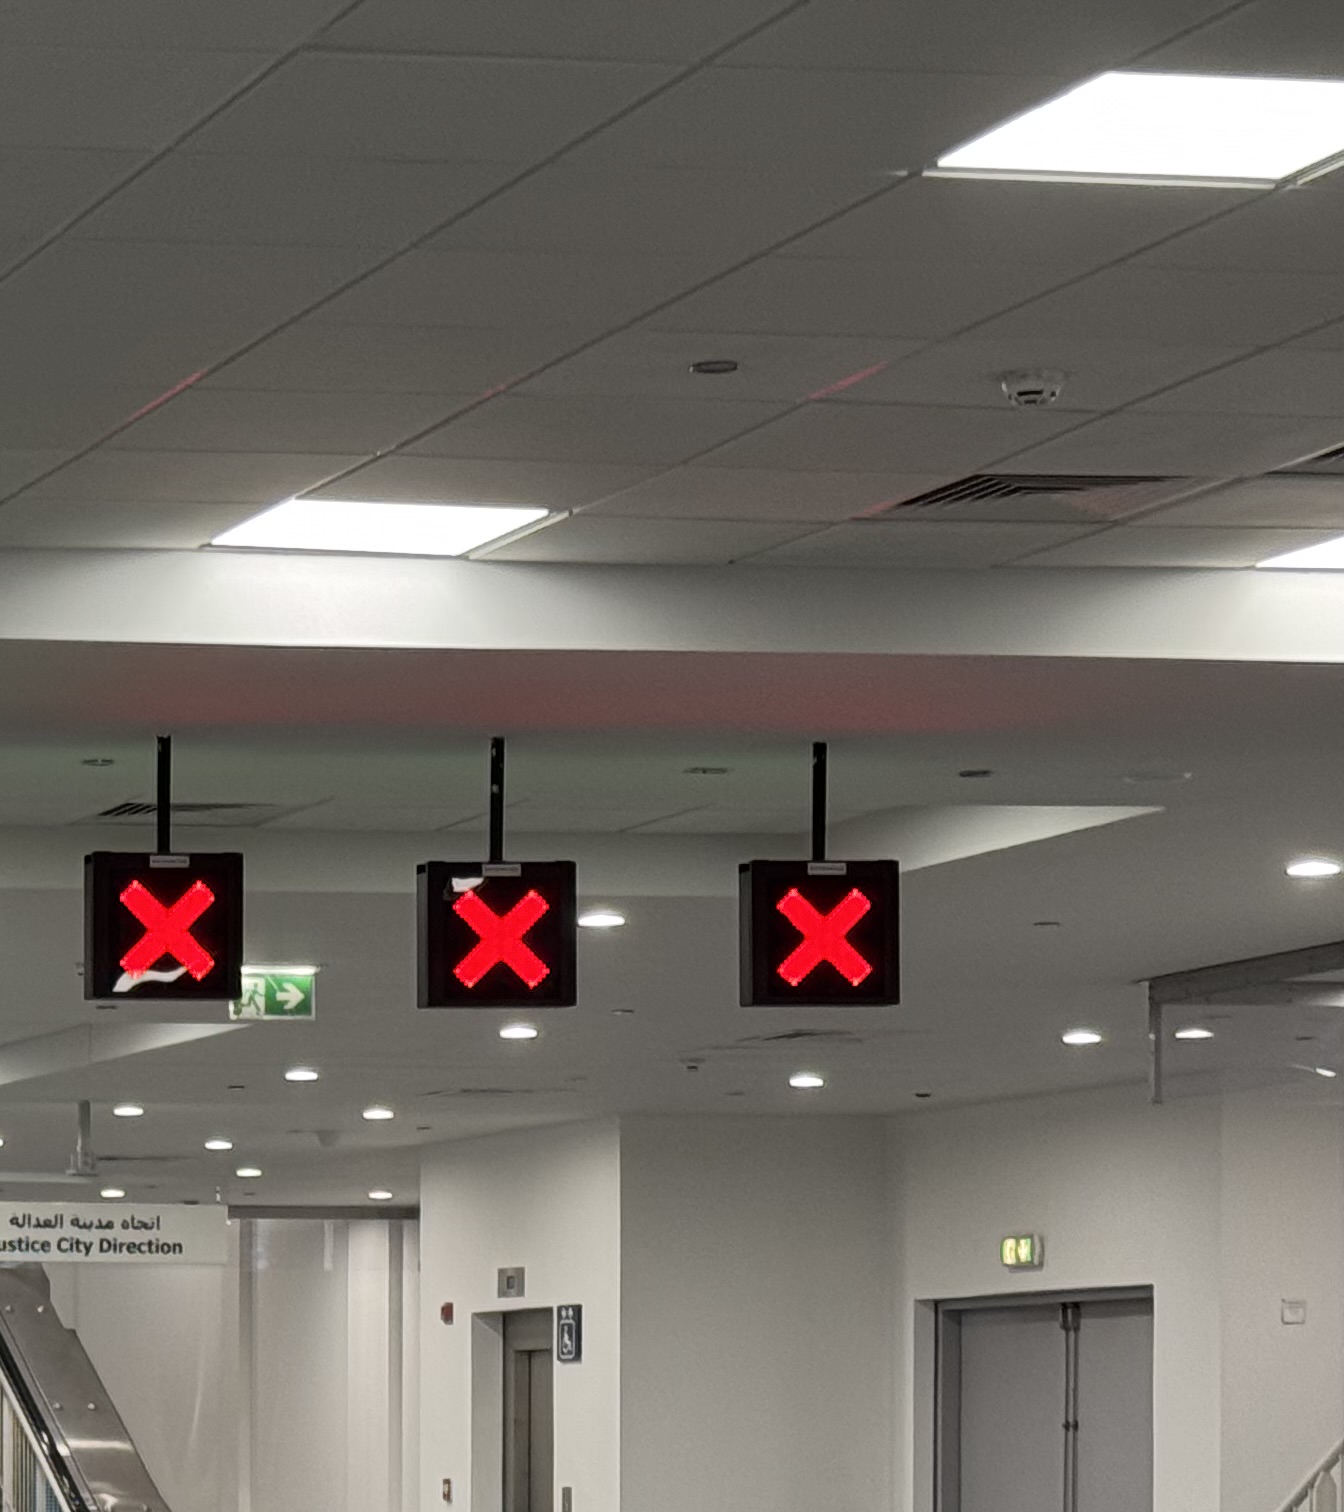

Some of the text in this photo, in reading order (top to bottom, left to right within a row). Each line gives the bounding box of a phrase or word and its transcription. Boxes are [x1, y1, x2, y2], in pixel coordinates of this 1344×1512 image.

[9, 1213, 64, 1230] العدالة
[56, 1237, 94, 1257] City
[98, 1237, 183, 1255] Direction
